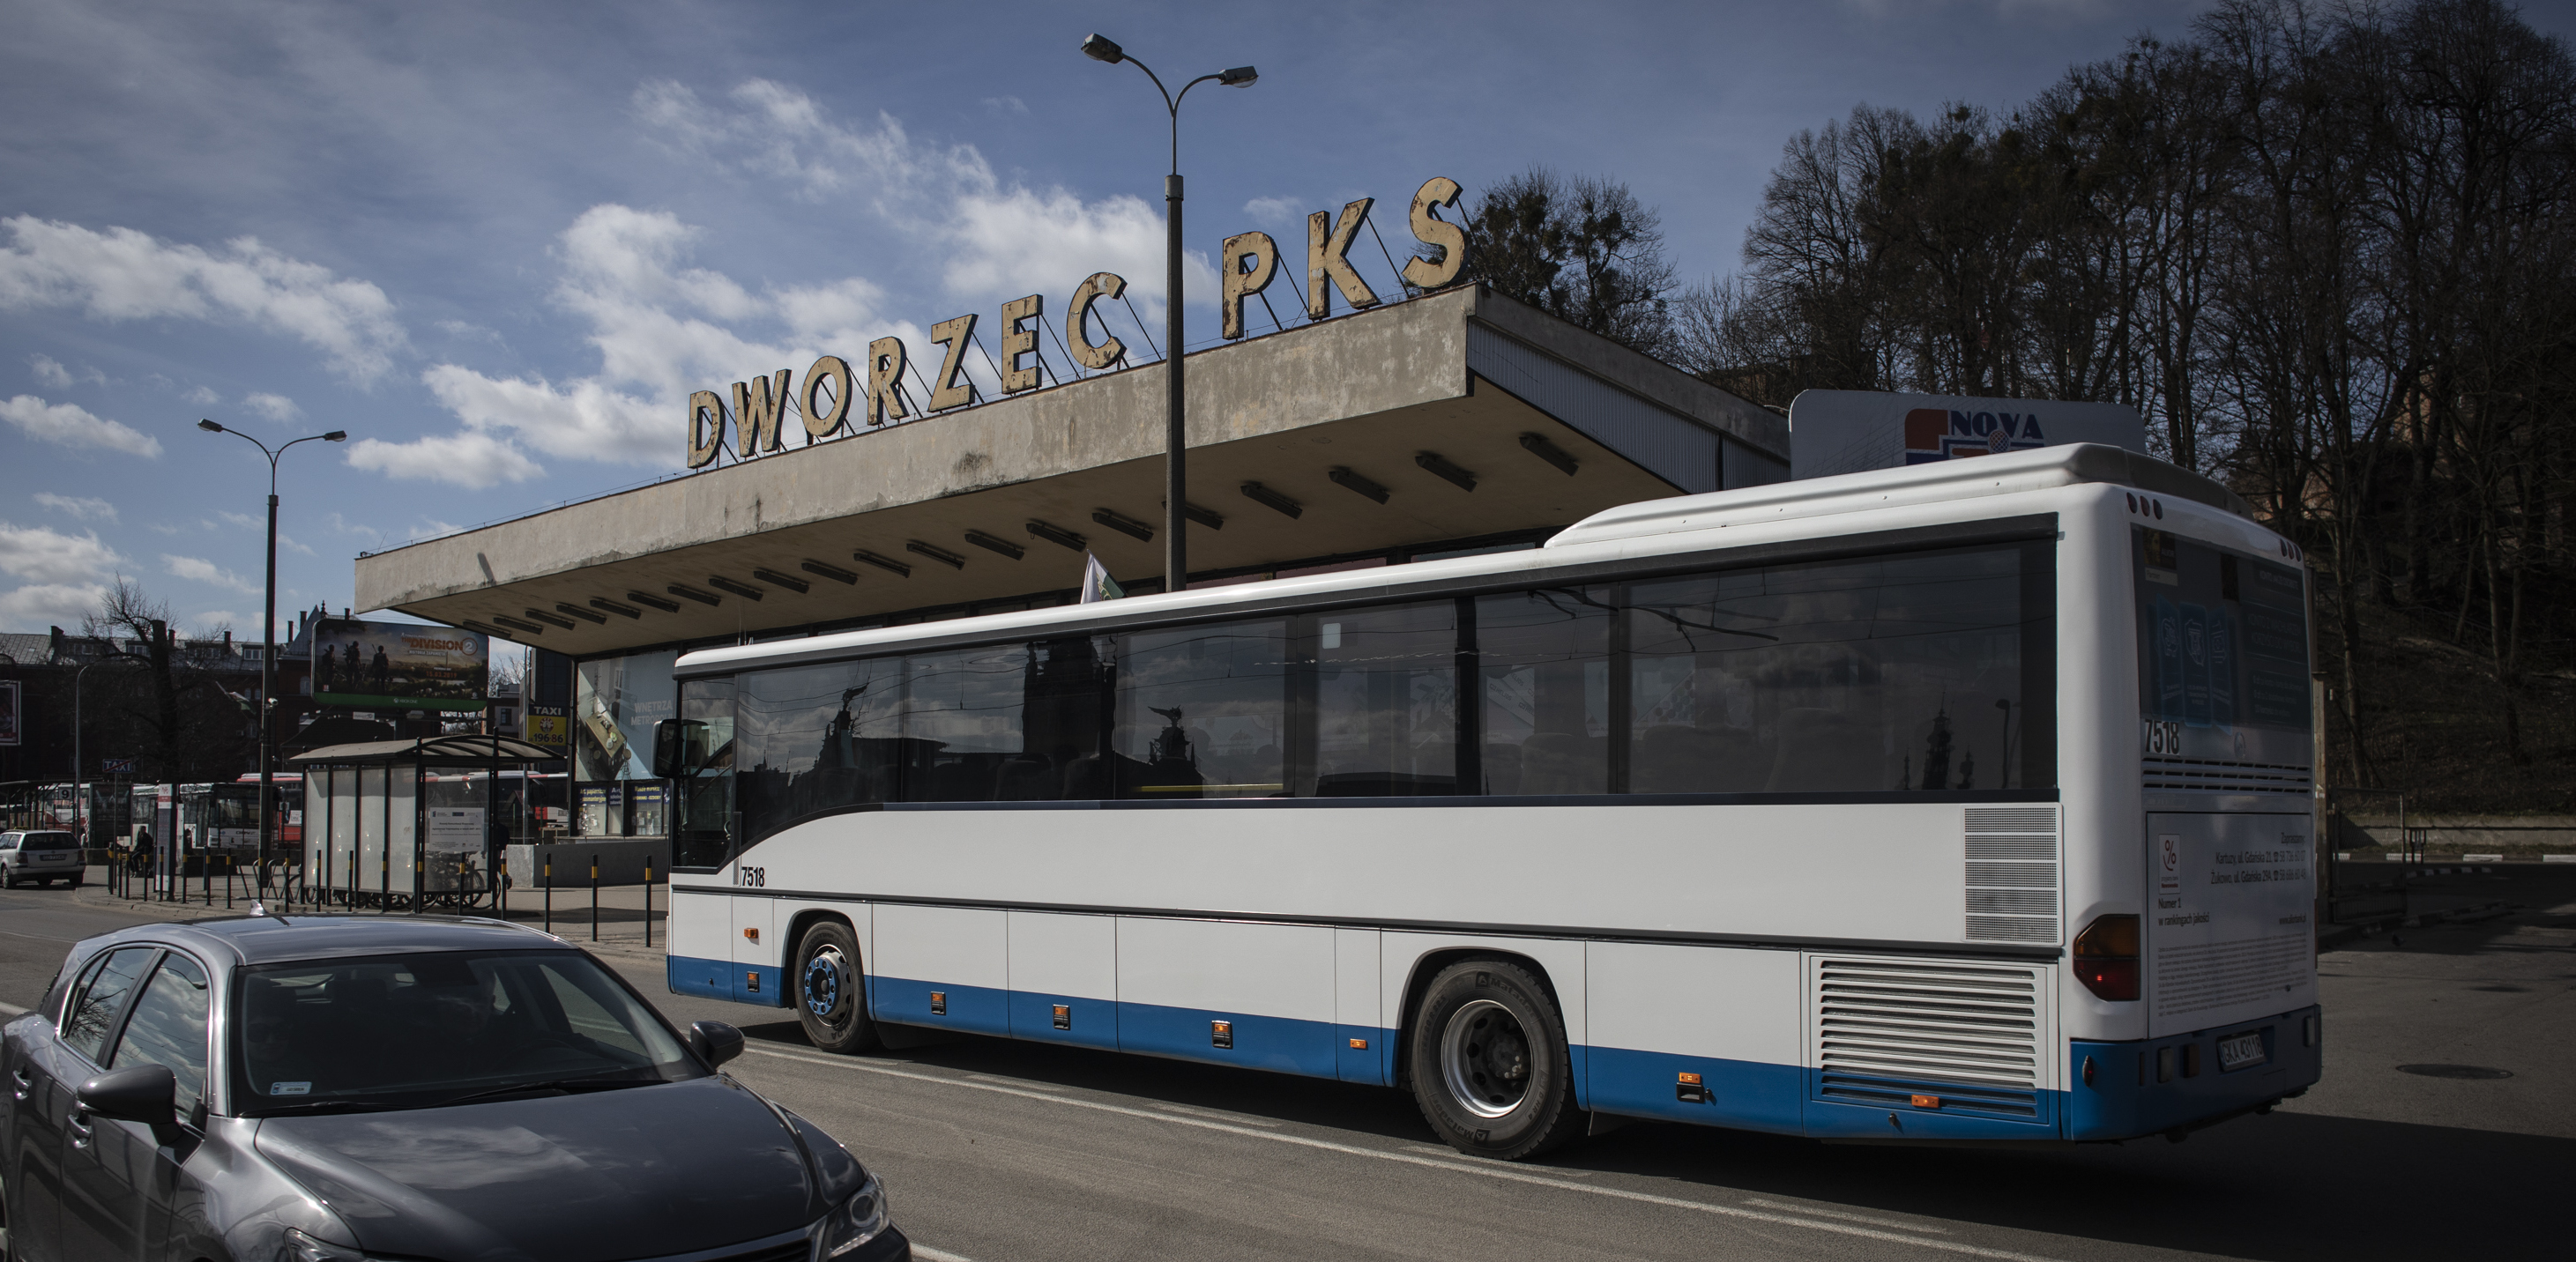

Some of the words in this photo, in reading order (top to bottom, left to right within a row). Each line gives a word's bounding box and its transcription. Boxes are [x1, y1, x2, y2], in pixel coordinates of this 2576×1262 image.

[687, 271, 1128, 470] DWORZEC
[1222, 176, 1468, 340] PKS
[1950, 410, 2044, 440] NOVA
[410, 637, 464, 651] DIVISION
[465, 642, 473, 652] 2
[533, 706, 562, 716] TAXI
[634, 700, 673, 715] WNĘTRZA
[2145, 718, 2179, 754] 7518
[104, 761, 130, 771] TAXI
[61, 790, 70, 799] 9
[2245, 850, 2265, 864] Gdańska
[741, 866, 765, 887] 7518
[2241, 870, 2261, 883] Gdańska
[2158, 898, 2177, 909] Numer
[2178, 897, 2182, 909] 1
[2158, 917, 2163, 926] w
[2164, 913, 2192, 927] rankingach
[2193, 912, 2210, 926] jakości
[1490, 977, 1538, 1020] Matador
[2222, 1040, 2241, 1064] GKA
[2239, 1036, 2263, 1059] 43118
[1432, 1098, 1475, 1140] Matador
